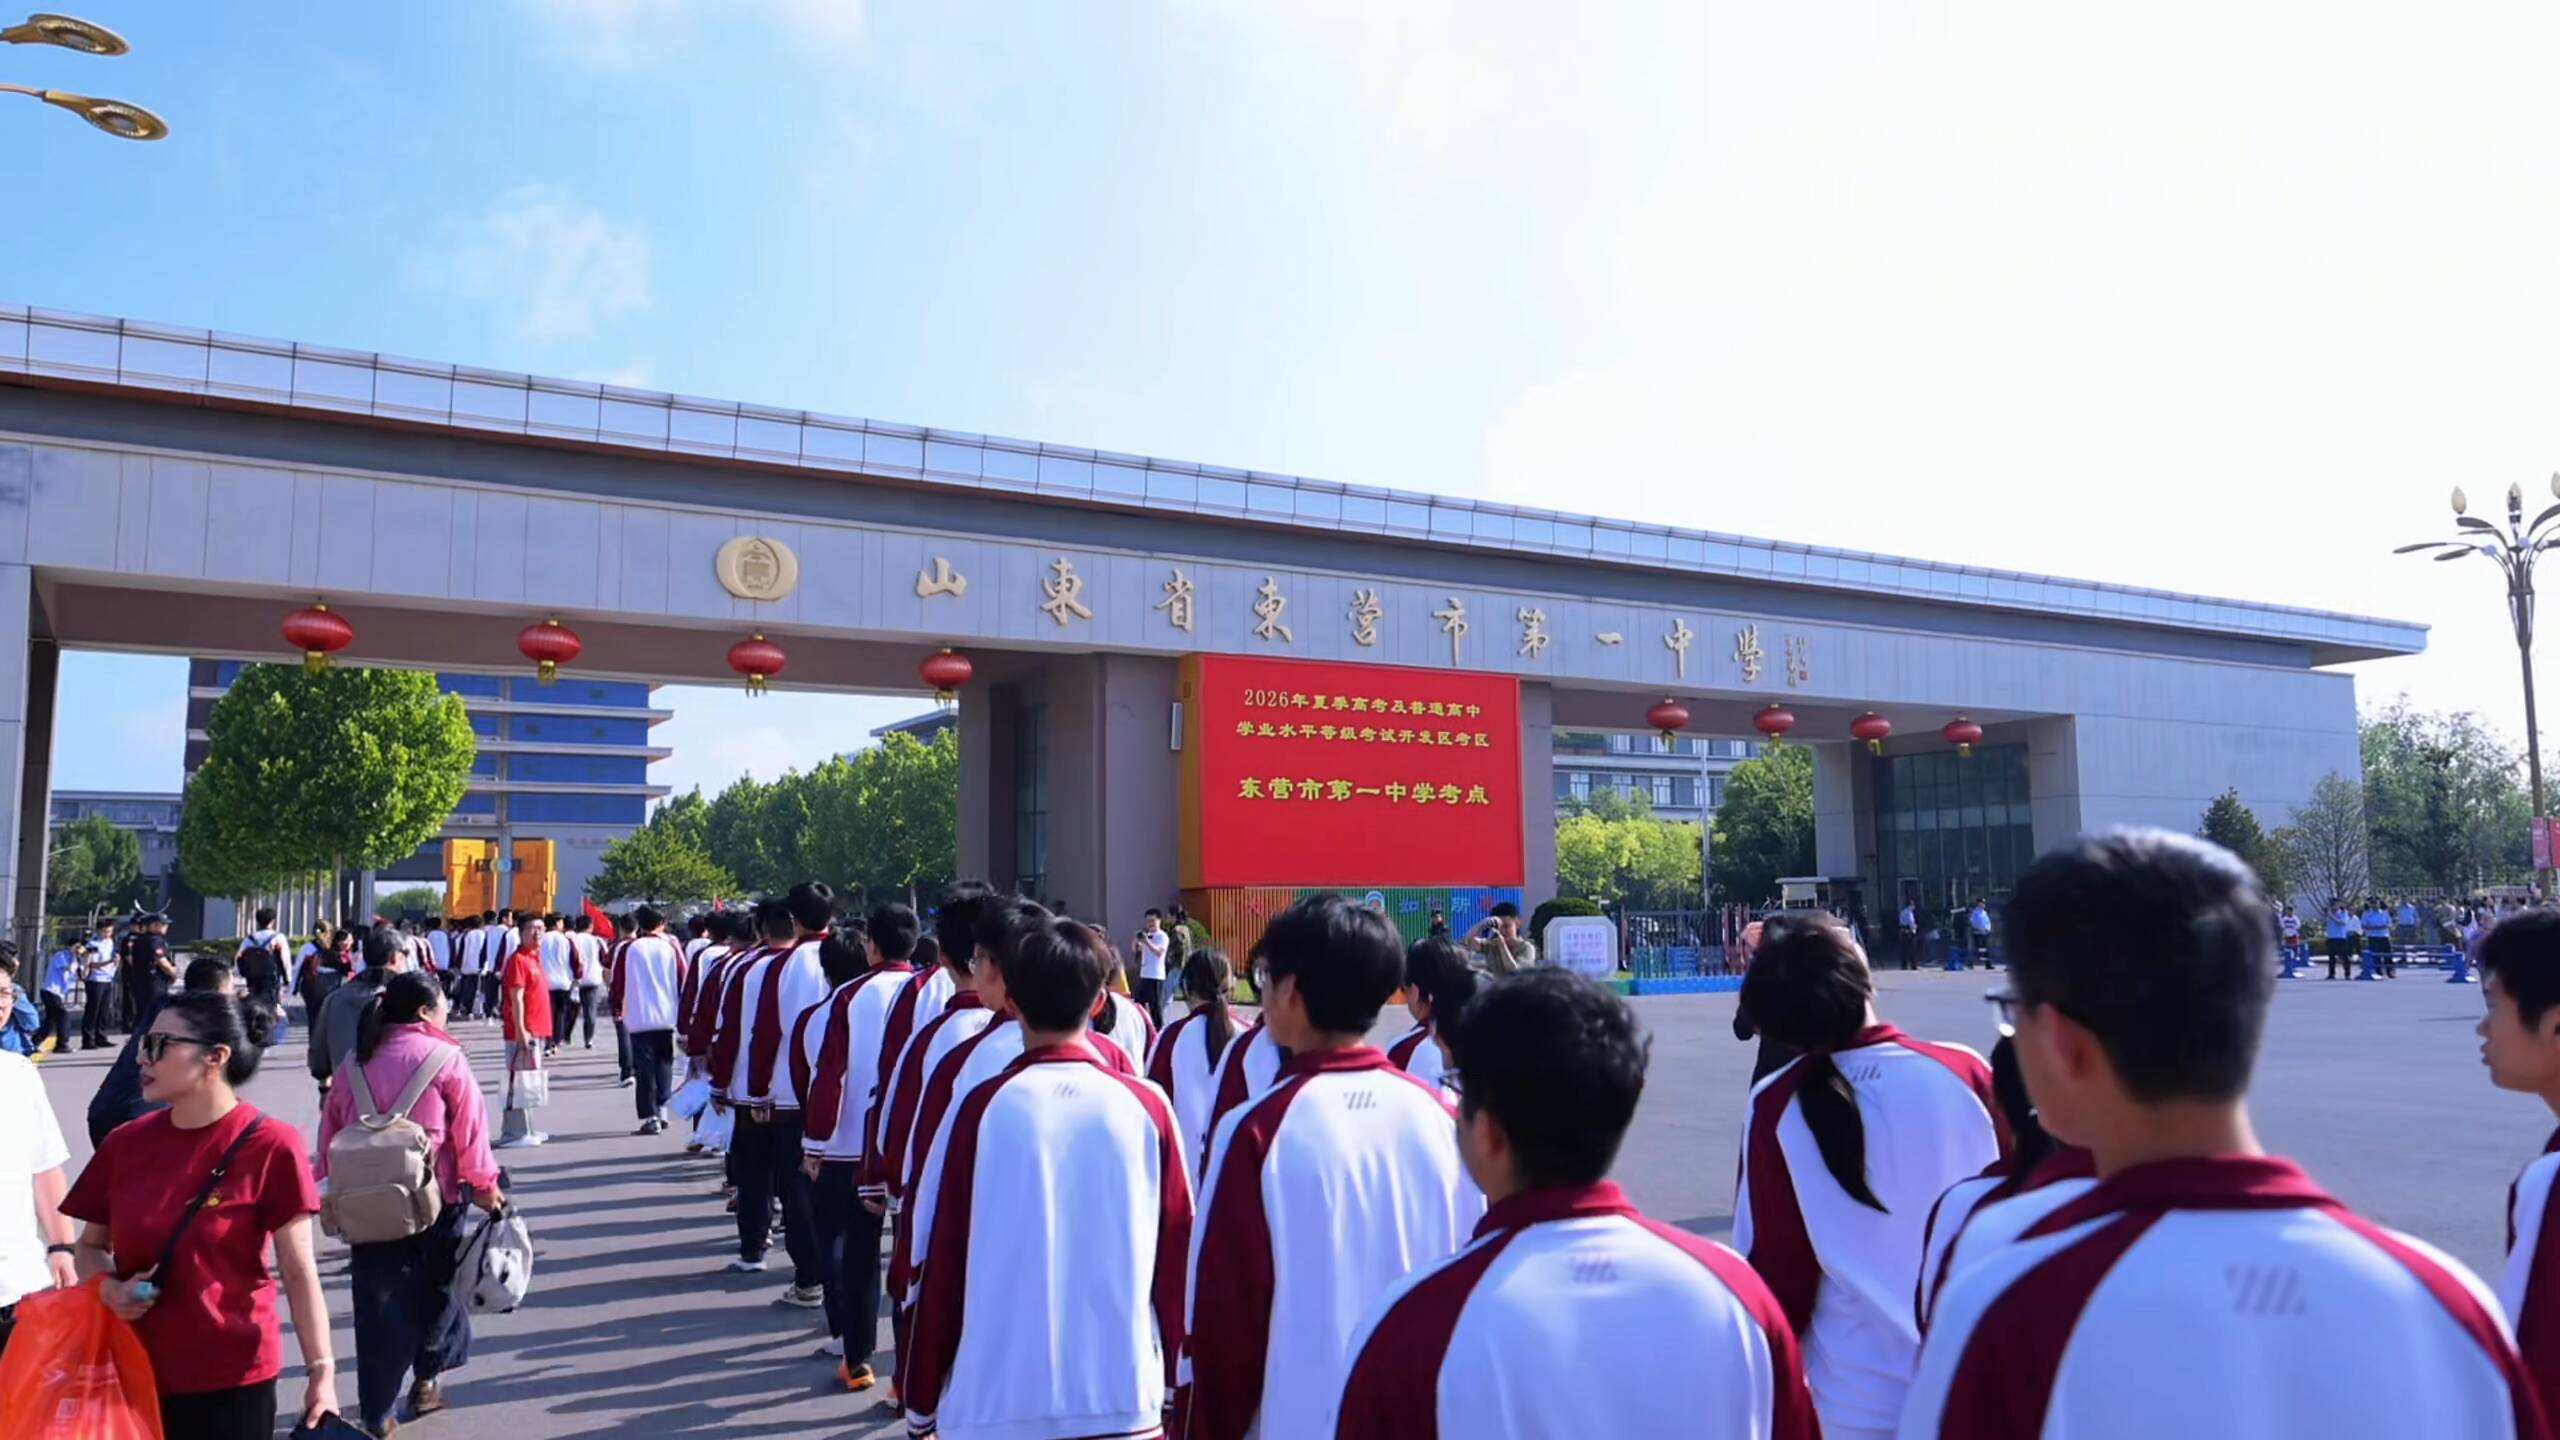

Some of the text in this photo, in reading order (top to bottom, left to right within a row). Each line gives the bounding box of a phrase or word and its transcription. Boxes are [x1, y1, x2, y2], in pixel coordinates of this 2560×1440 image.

[1244, 688, 1481, 718] 2026年夏季高考及普通高中
[1236, 720, 1490, 748] 学业水平等级考试开发区考区
[1238, 777, 1490, 805] 东营市第一中学考点
